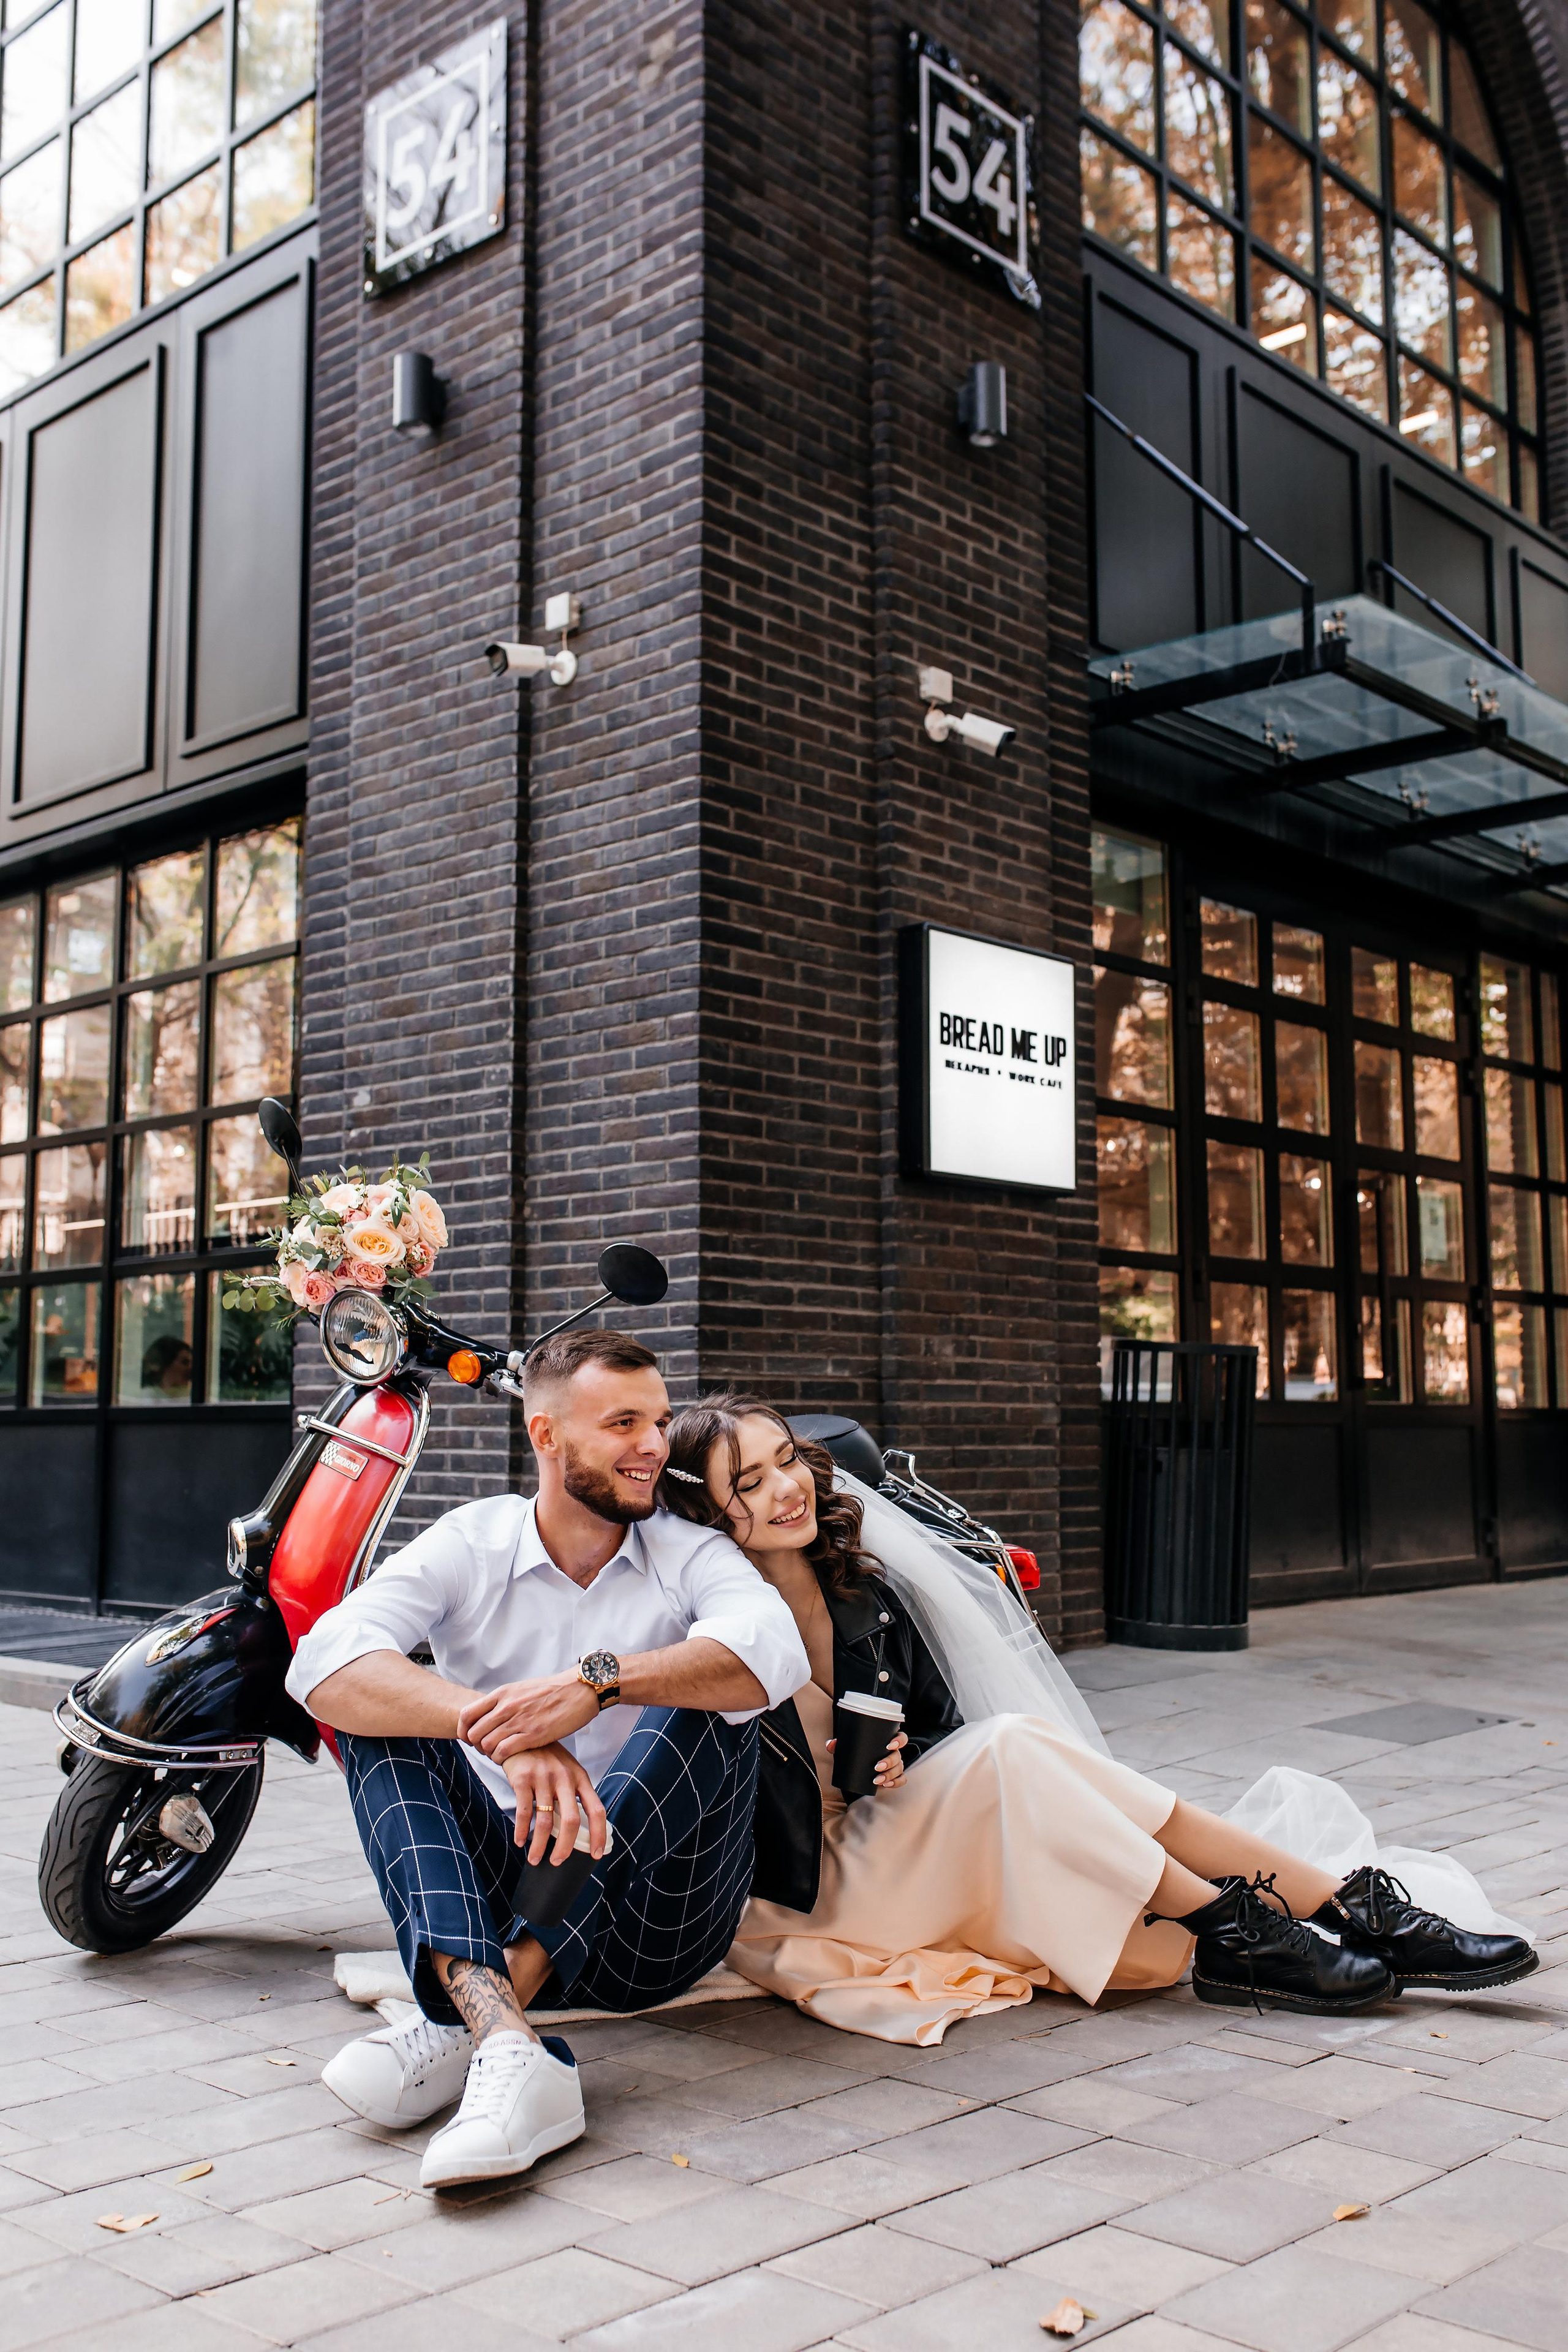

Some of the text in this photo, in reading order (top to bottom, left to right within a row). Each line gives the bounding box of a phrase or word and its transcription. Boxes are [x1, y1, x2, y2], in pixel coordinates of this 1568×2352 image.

[386, 99, 476, 230] 54
[930, 102, 1017, 237] 54
[940, 1012, 1066, 1067] BREAD ME UP
[1009, 1072, 1035, 1084] WORK
[334, 1455, 360, 1472] GIORNO
